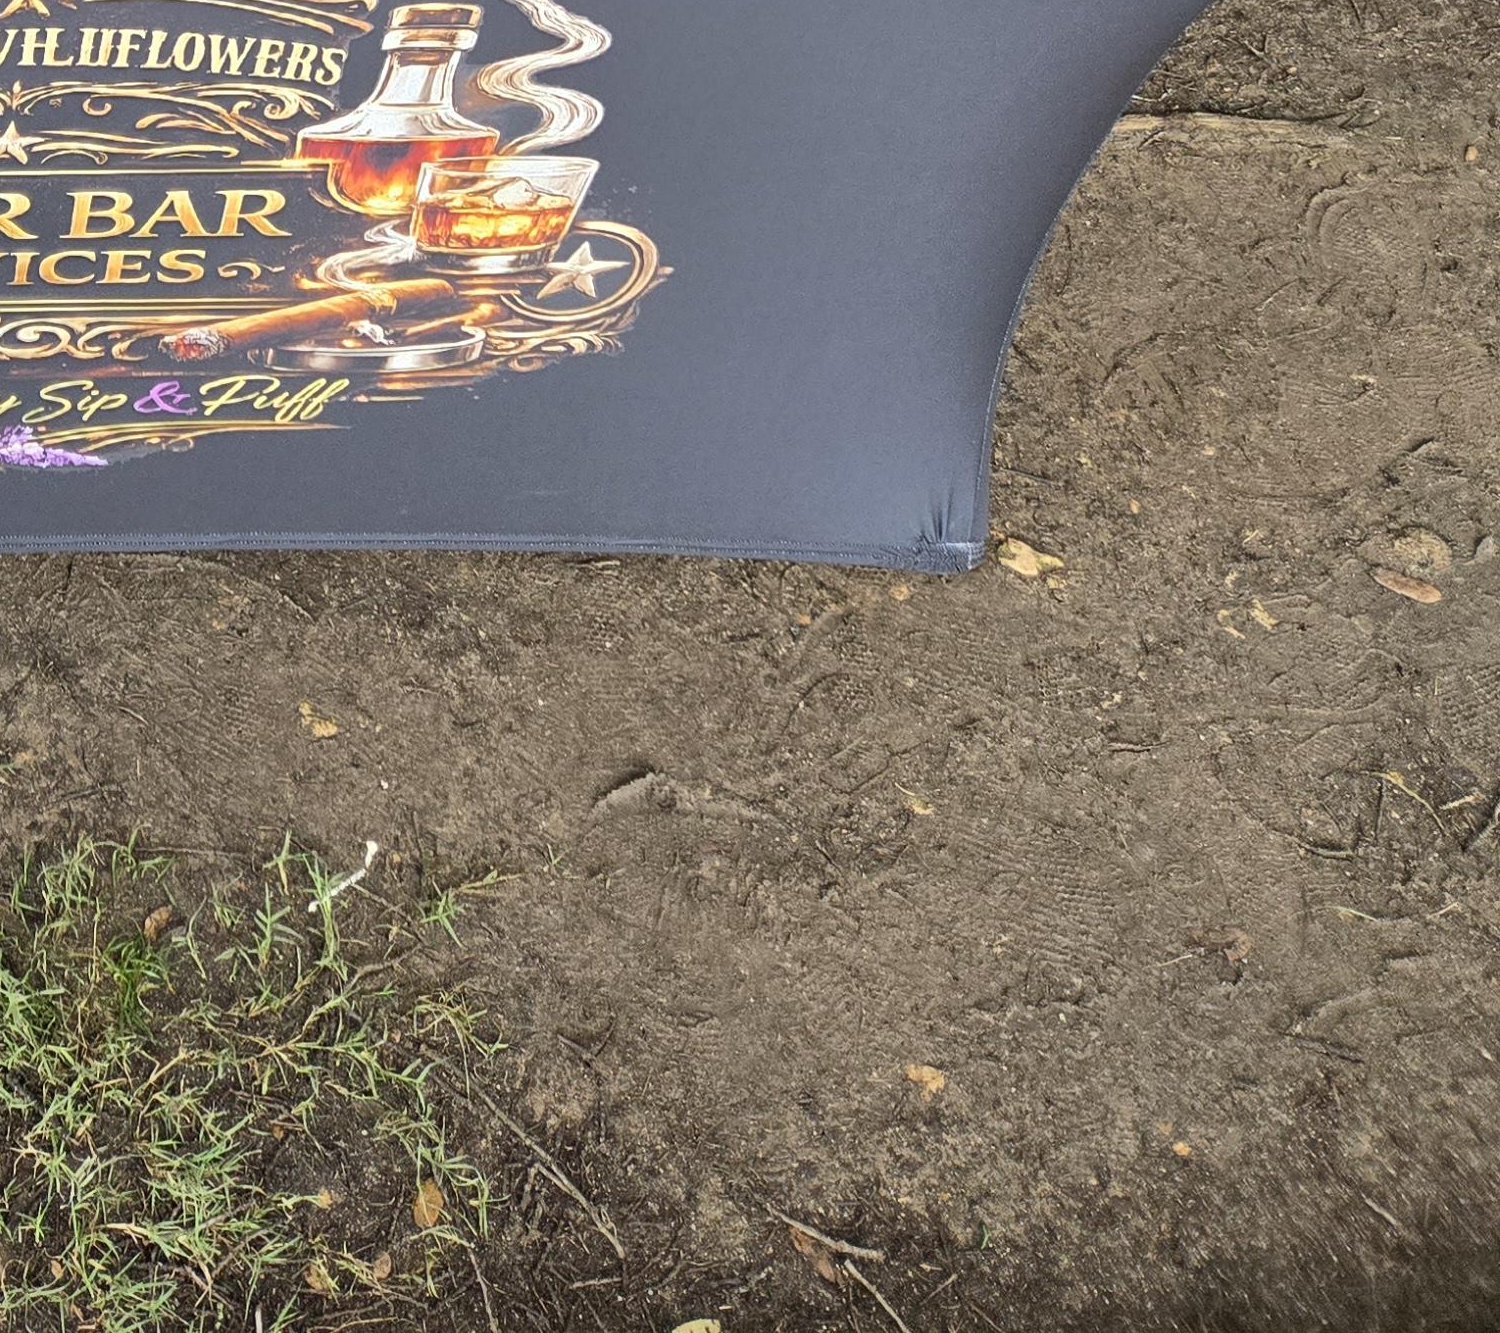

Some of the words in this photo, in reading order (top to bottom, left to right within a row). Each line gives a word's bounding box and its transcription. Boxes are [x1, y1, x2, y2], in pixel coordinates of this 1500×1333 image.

[63, 188, 293, 238] BAR
[23, 379, 129, 423] Sip
[133, 379, 199, 416] &
[199, 375, 350, 423] Puff
